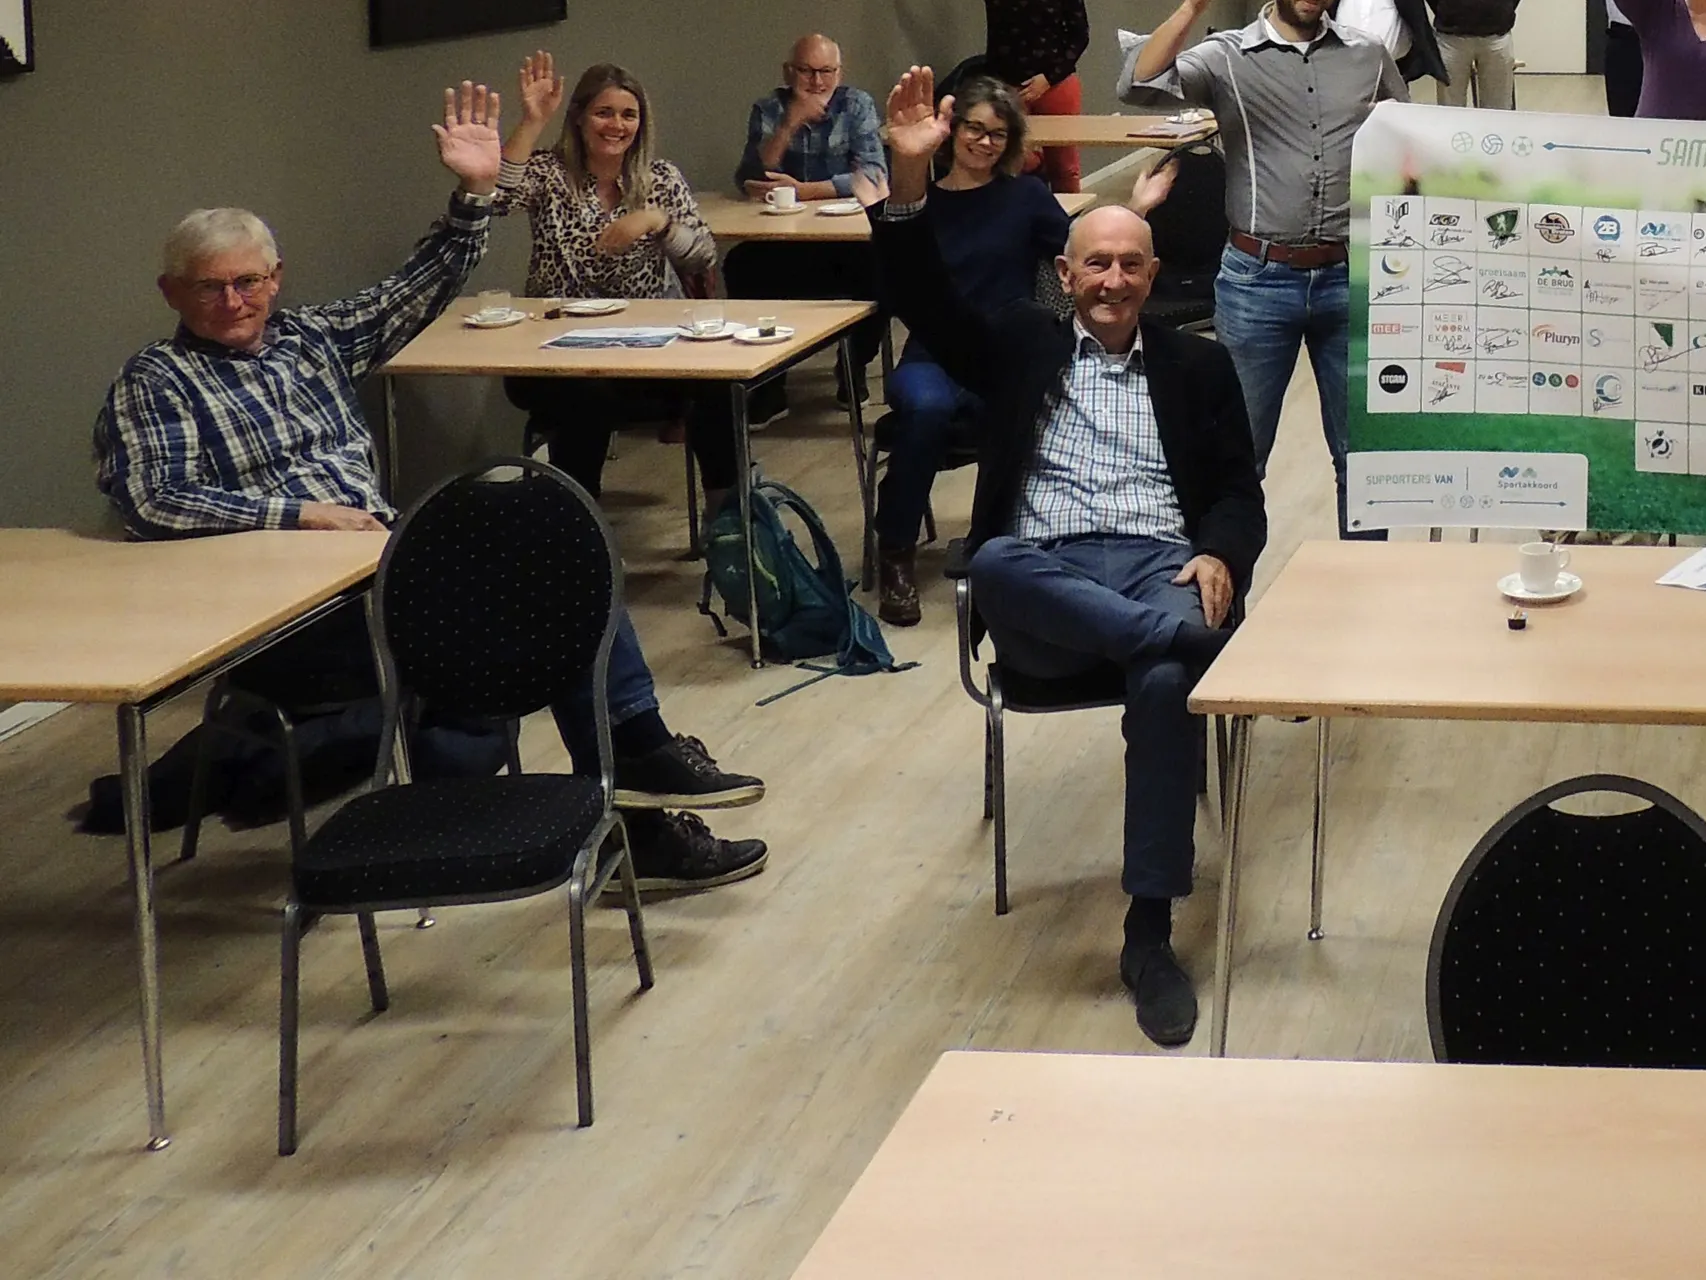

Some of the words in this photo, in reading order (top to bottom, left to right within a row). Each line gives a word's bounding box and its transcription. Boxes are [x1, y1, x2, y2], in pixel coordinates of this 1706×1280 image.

[1430, 215, 1459, 226] GGD
[1552, 279, 1574, 288] BRUG
[1544, 332, 1580, 346] Pluryn
[1380, 375, 1406, 384] STORM
[1366, 474, 1431, 485] SUPPORTERS
[1435, 474, 1453, 484] VAN
[1498, 480, 1558, 489] Sportakkoord
